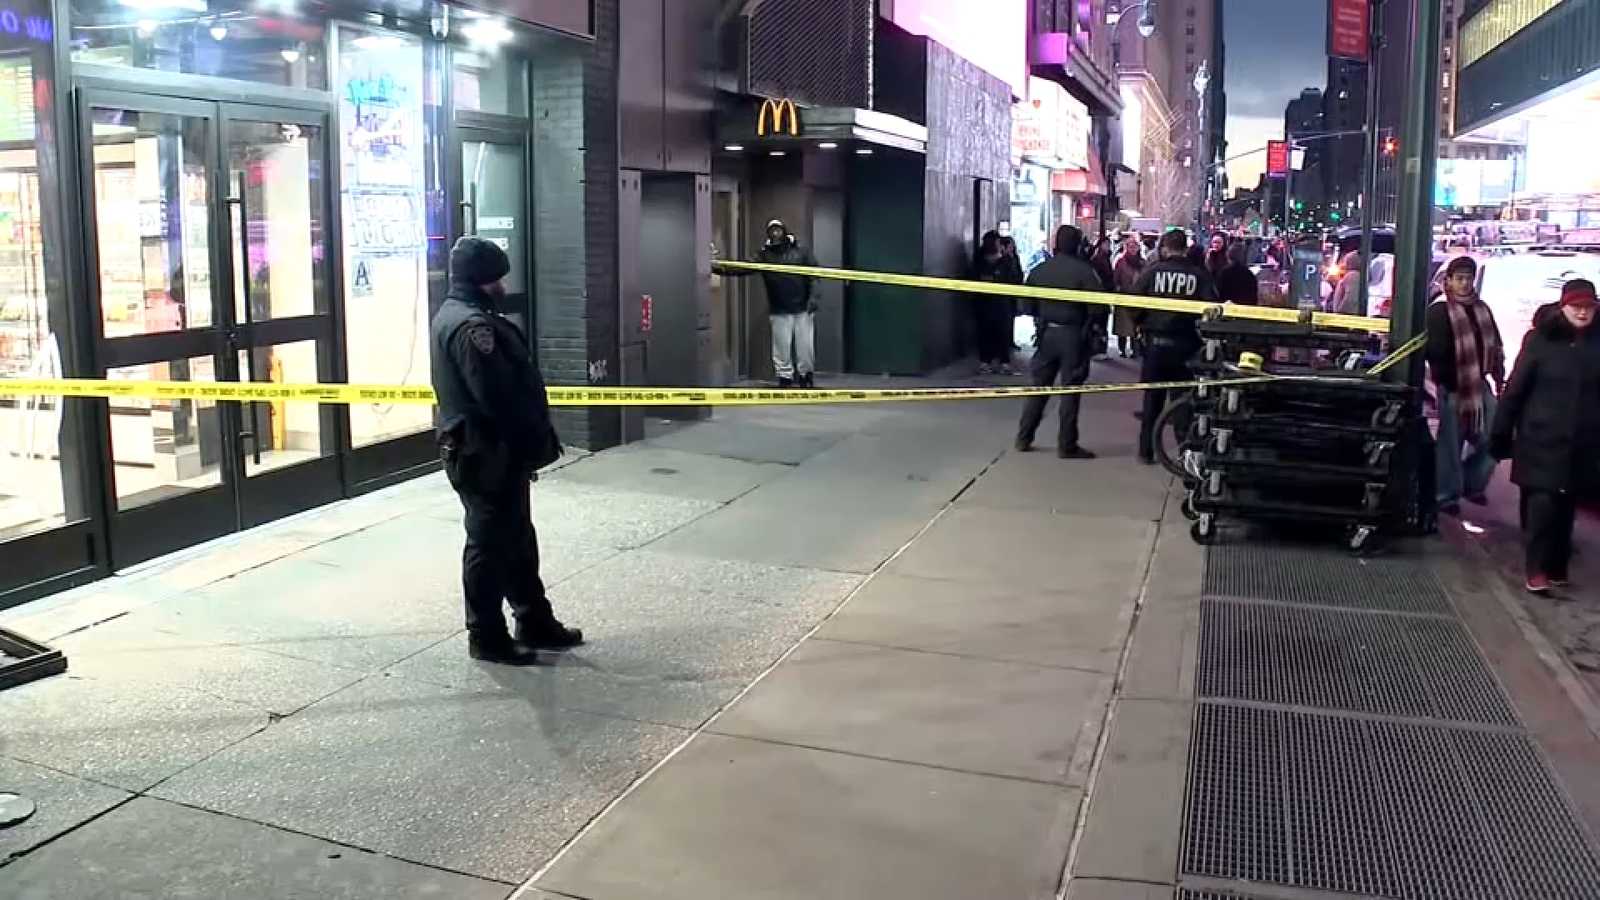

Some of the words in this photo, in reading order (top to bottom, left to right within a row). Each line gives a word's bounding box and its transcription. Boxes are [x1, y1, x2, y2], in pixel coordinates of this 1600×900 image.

[354, 260, 369, 286] A
[1154, 271, 1198, 296] NYPD
[1304, 264, 1316, 281] P
